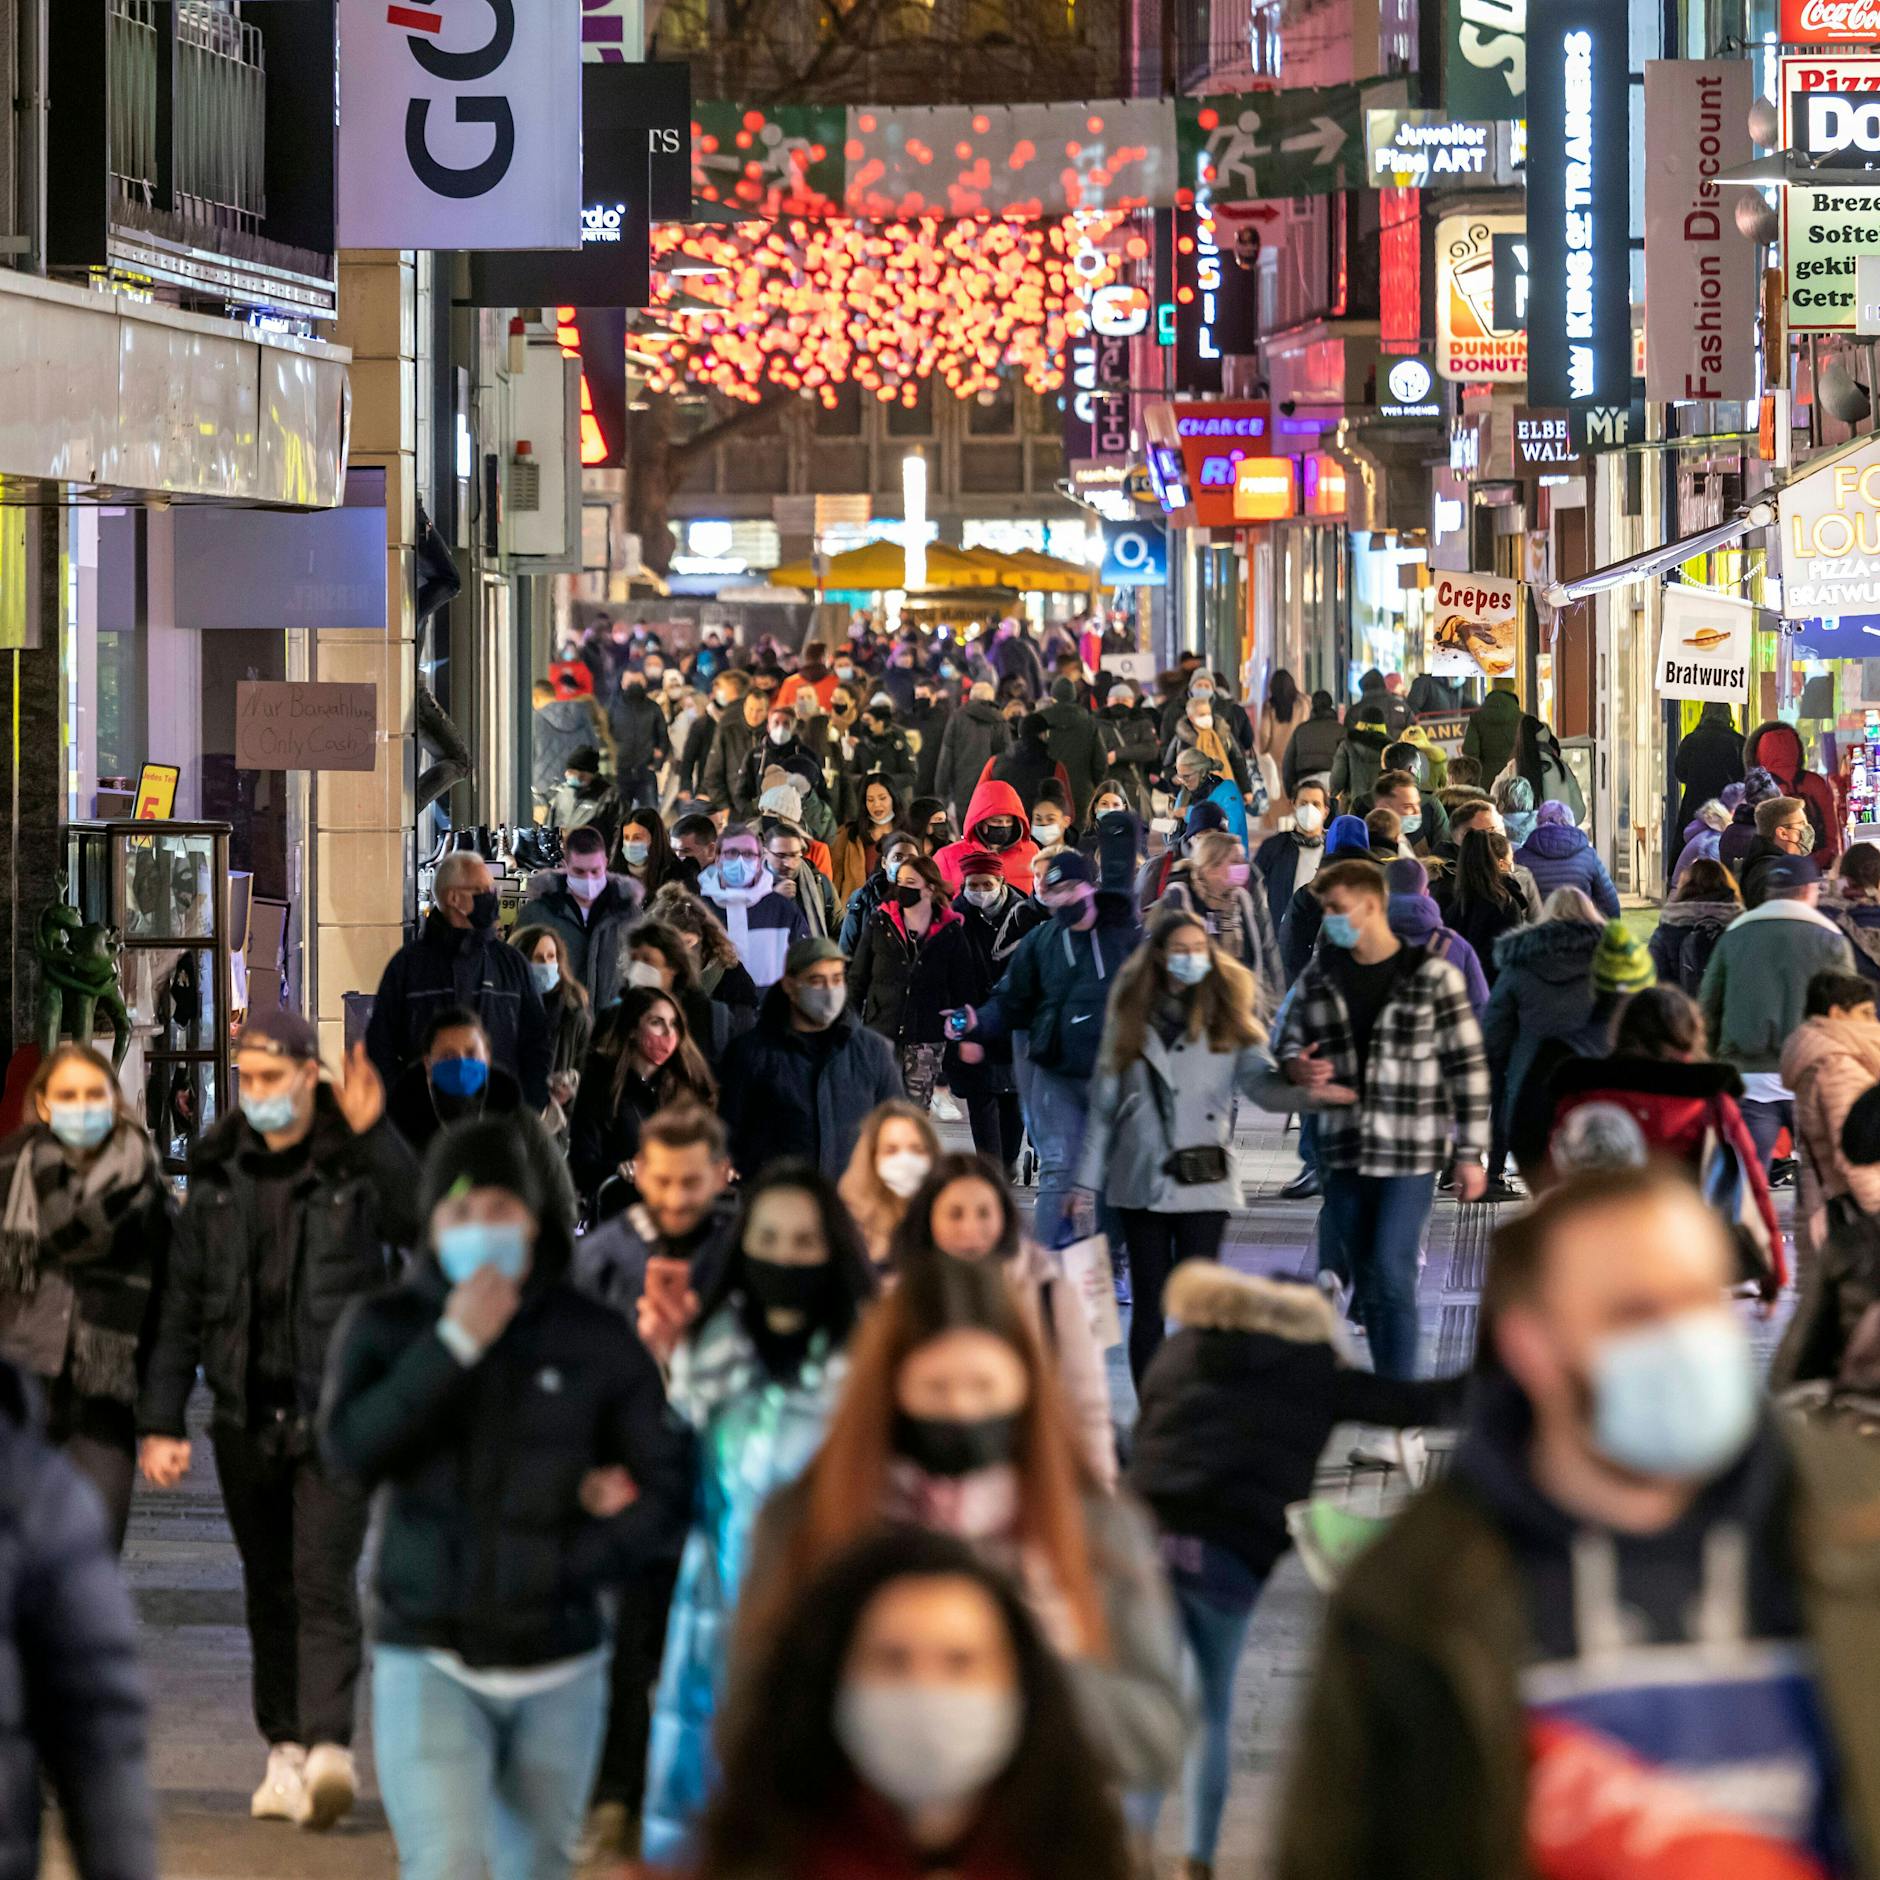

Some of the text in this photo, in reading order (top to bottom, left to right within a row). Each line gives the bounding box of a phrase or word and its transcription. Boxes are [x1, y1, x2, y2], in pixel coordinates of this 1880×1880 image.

[1433, 148, 1487, 172] ART
[1684, 76, 1722, 399] Fashion Discount
[1792, 288, 1856, 307] Getr
[1808, 558, 1871, 581] PIZZA
[1437, 581, 1512, 616] Crêpes
[1665, 661, 1745, 690] Bratwurst
